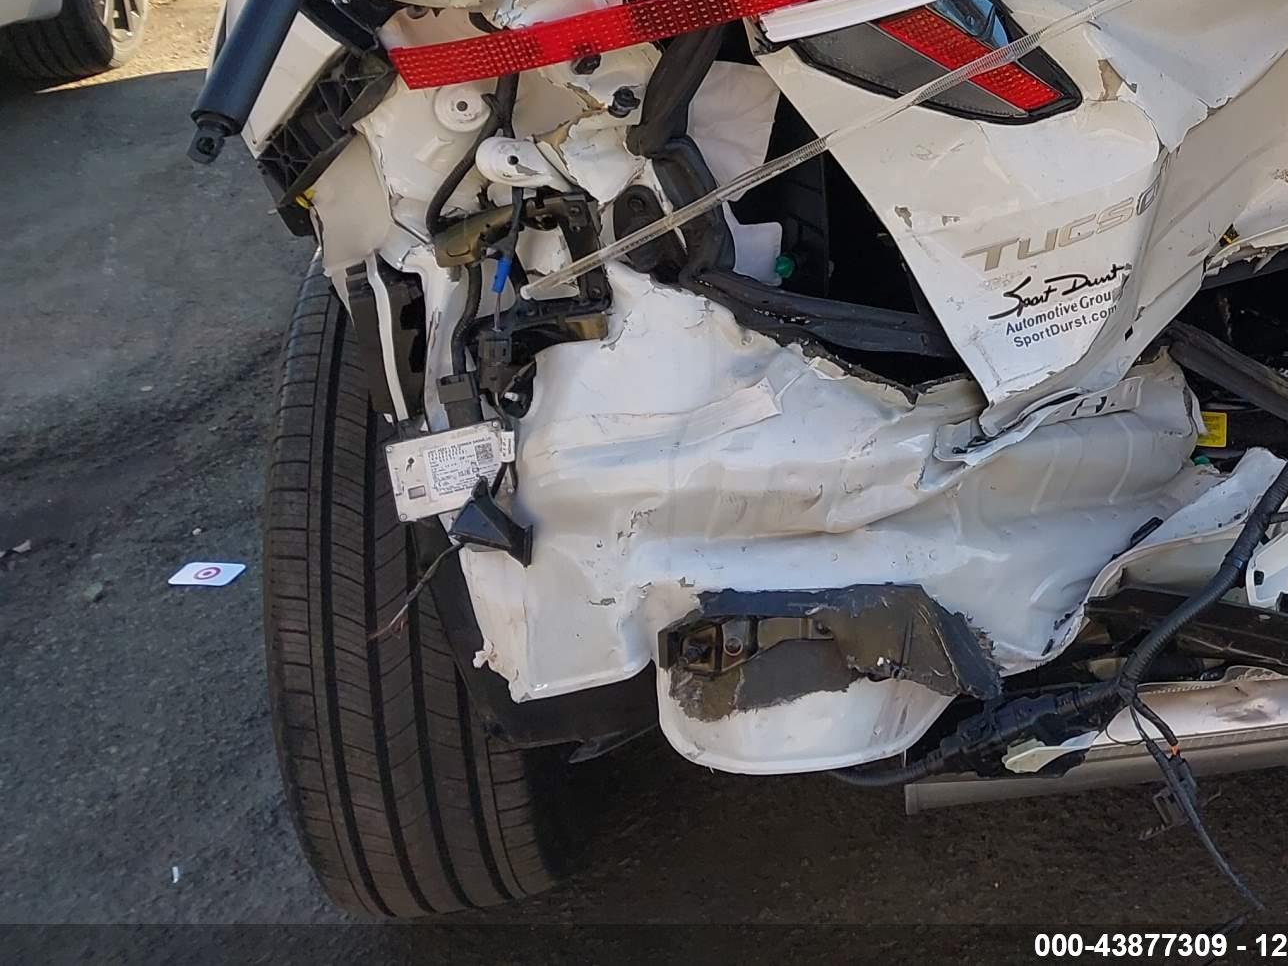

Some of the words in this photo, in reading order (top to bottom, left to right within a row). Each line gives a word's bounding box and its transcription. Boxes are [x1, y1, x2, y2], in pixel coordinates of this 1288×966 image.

[988, 275, 1058, 321] Sport
[1005, 300, 1078, 336] Automotive
[1079, 290, 1113, 310] Grou
[1013, 304, 1118, 348] SportDurst.com
